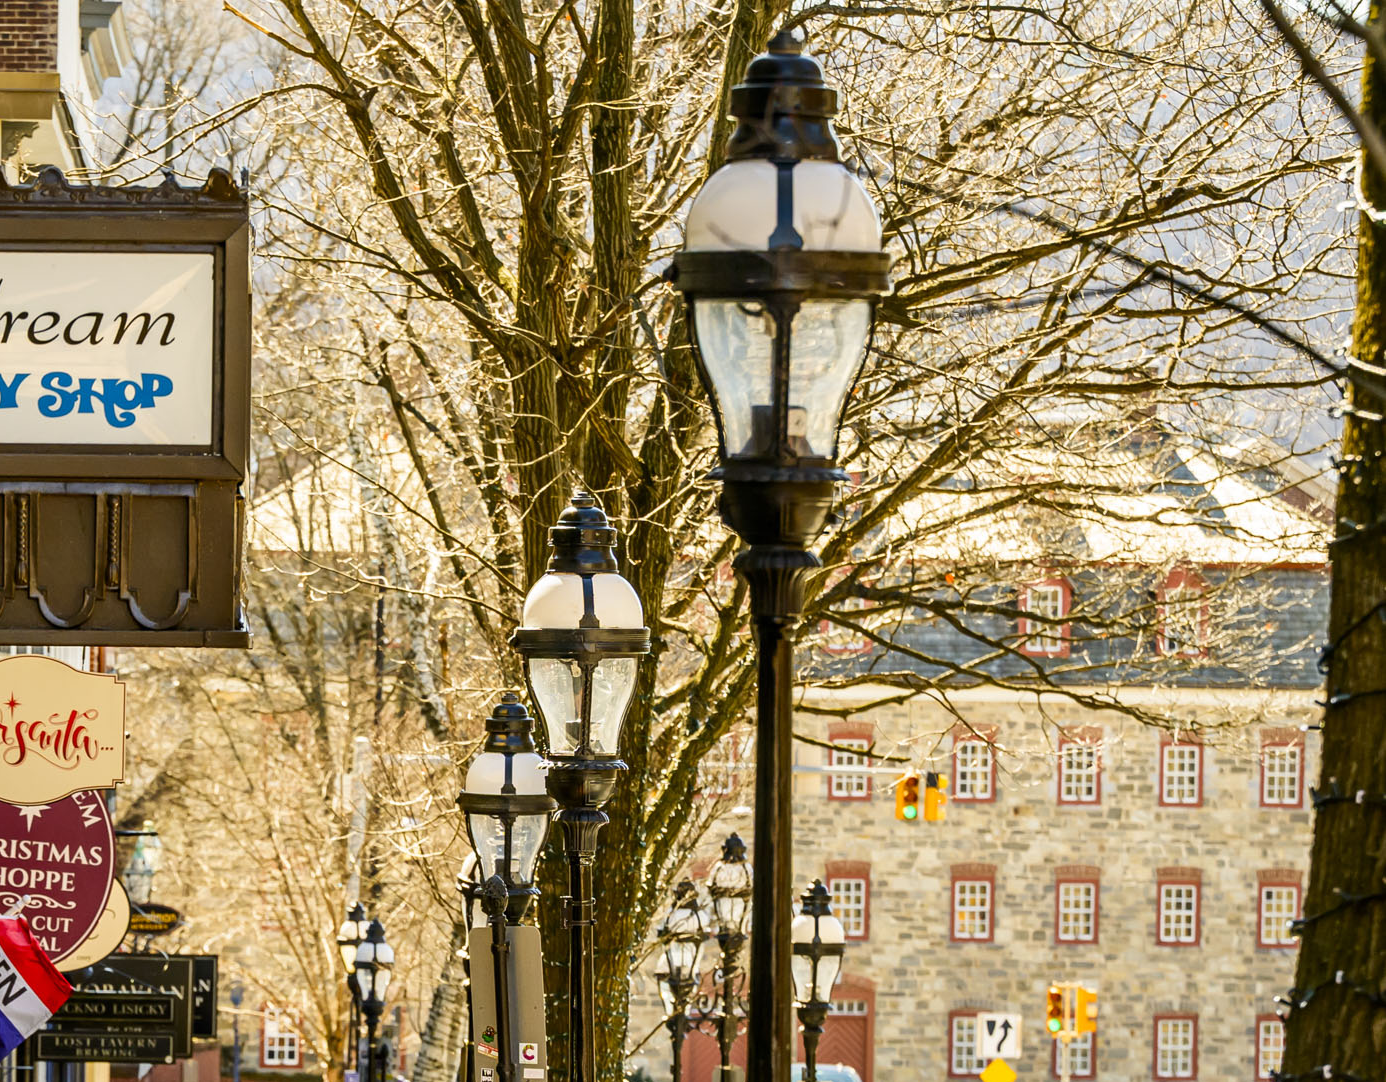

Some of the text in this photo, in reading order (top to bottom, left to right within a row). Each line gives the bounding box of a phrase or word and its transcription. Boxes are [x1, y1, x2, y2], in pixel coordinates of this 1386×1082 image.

[38, 371, 174, 428] SHOP
[31, 915, 74, 933] CUT
[113, 1003, 167, 1015] LISICKY
[54, 1036, 157, 1049] LOST TAVERN
[75, 1048, 137, 1057] BREWING
